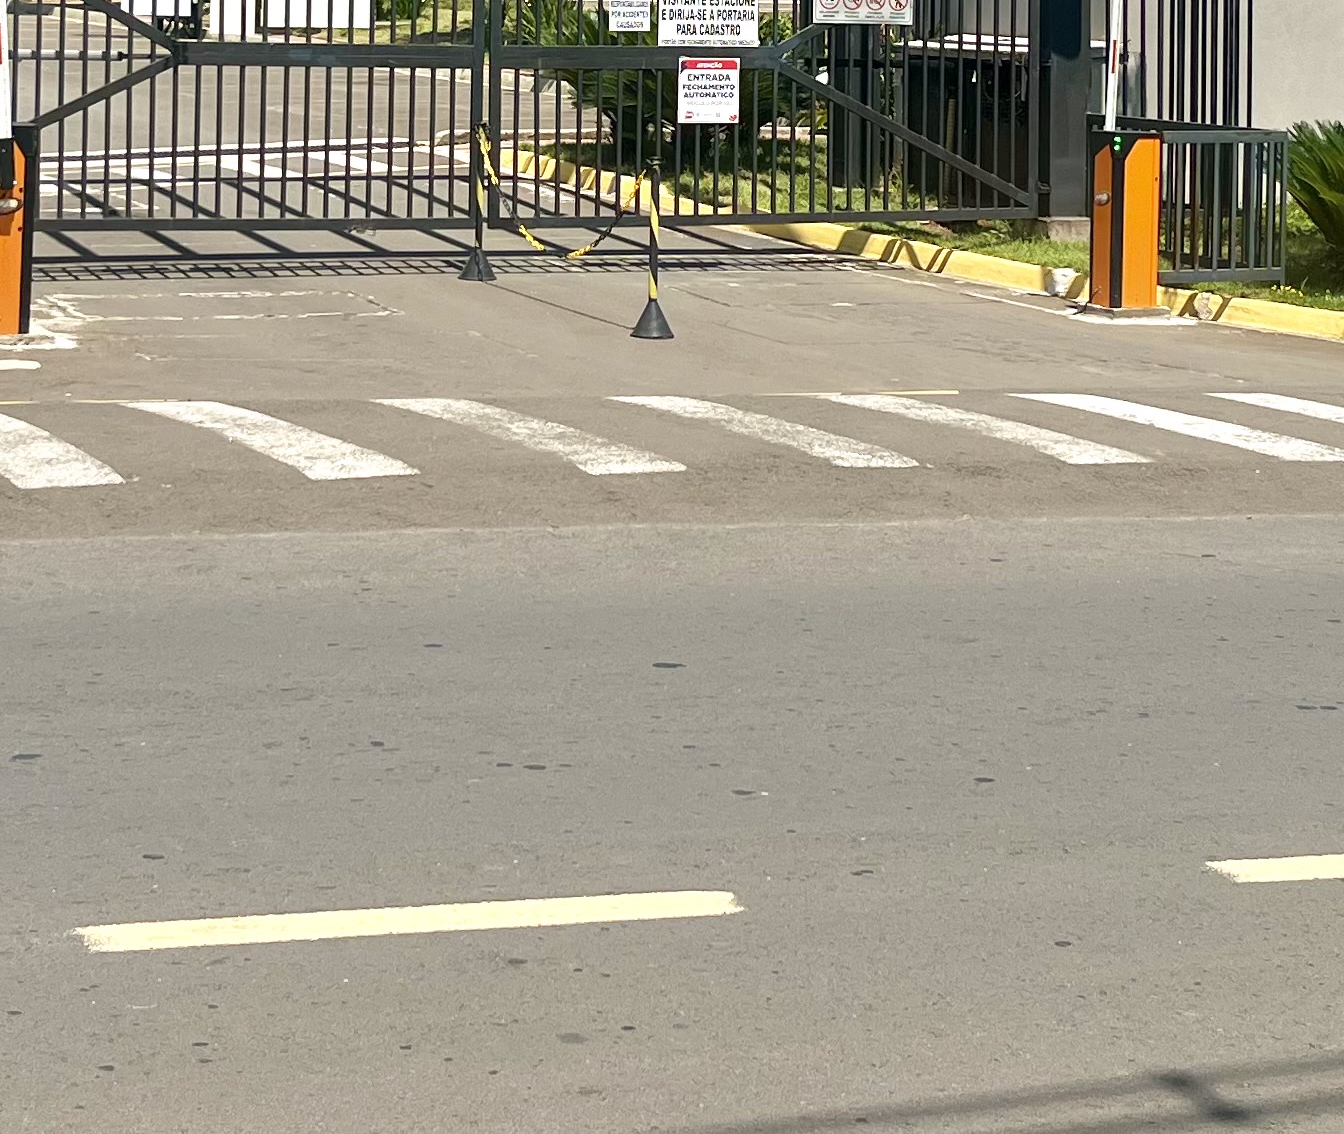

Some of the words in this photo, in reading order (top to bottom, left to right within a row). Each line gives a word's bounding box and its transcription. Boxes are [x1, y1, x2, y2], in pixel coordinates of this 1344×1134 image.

[662, 9, 666, 20] E
[669, 9, 707, 21] DIRIJA-SE
[716, 9, 755, 21] PORTARIA
[676, 24, 697, 35] PARA
[699, 24, 741, 36] CADASTRO
[687, 73, 731, 81] ENTRADA
